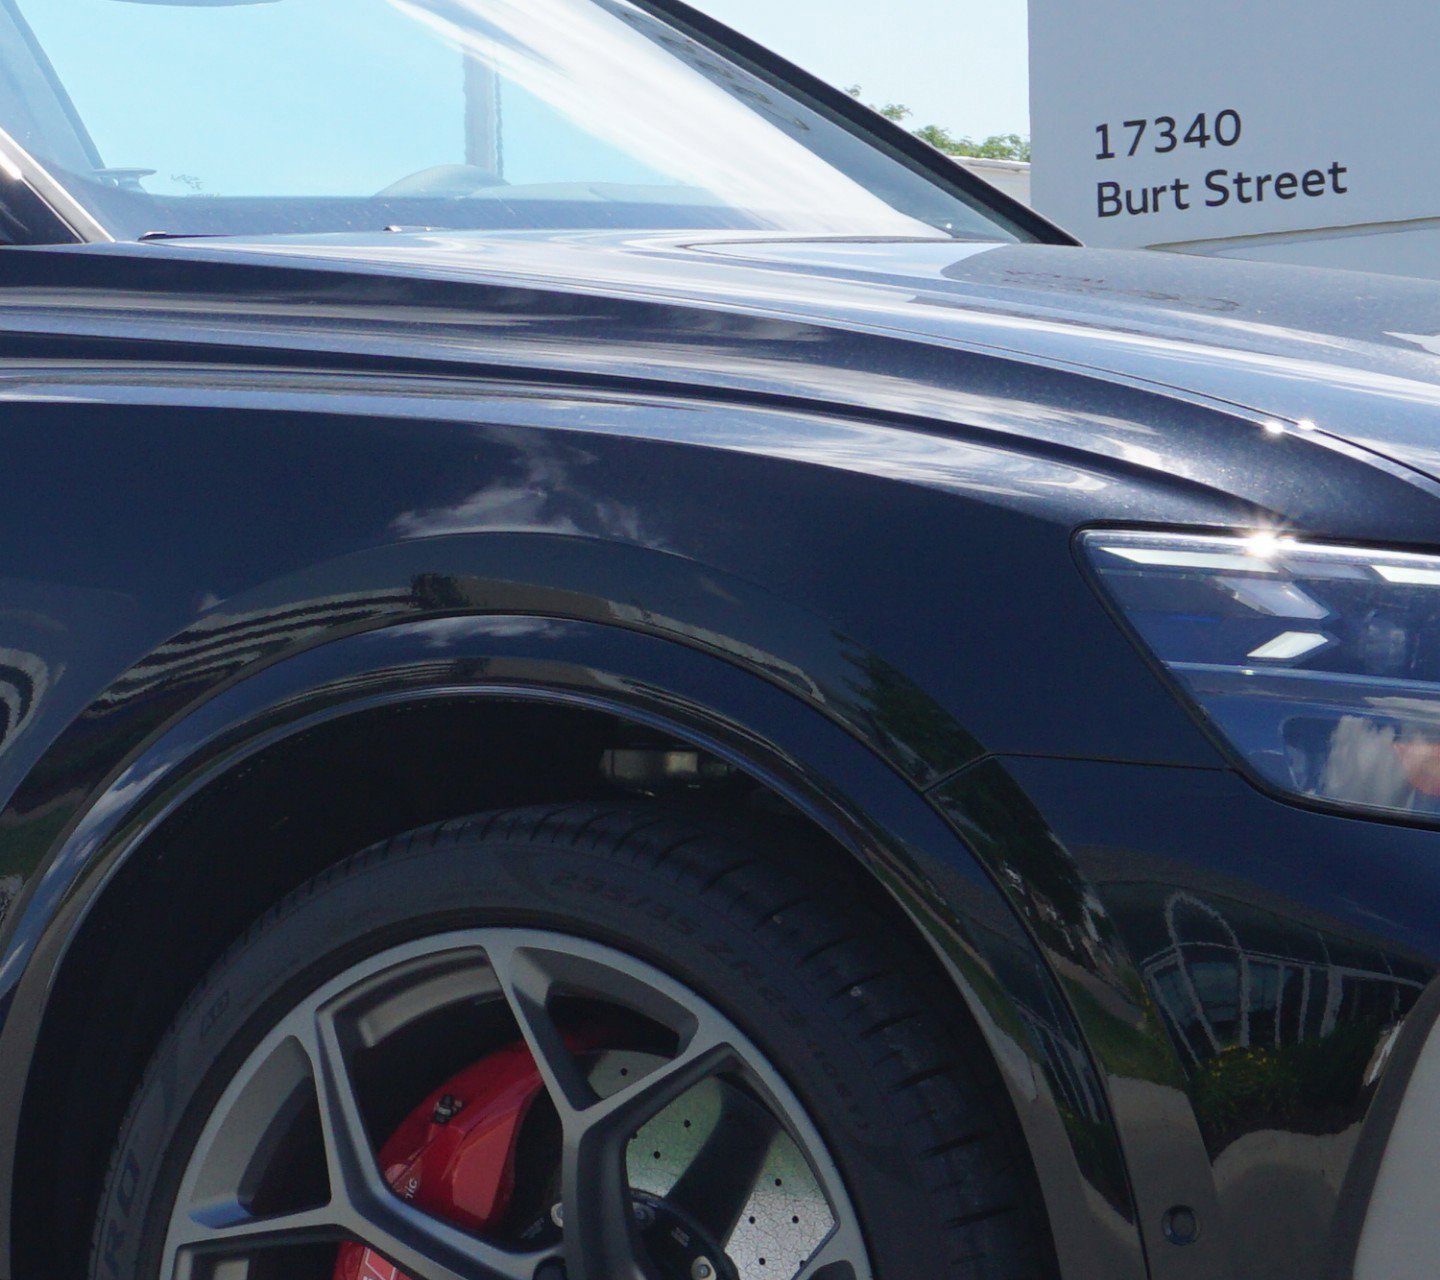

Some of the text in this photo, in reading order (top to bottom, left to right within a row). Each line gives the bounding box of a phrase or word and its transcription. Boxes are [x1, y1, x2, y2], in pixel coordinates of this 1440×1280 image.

[1094, 108, 1242, 160] 17340
[1096, 160, 1349, 219] Burt Street
